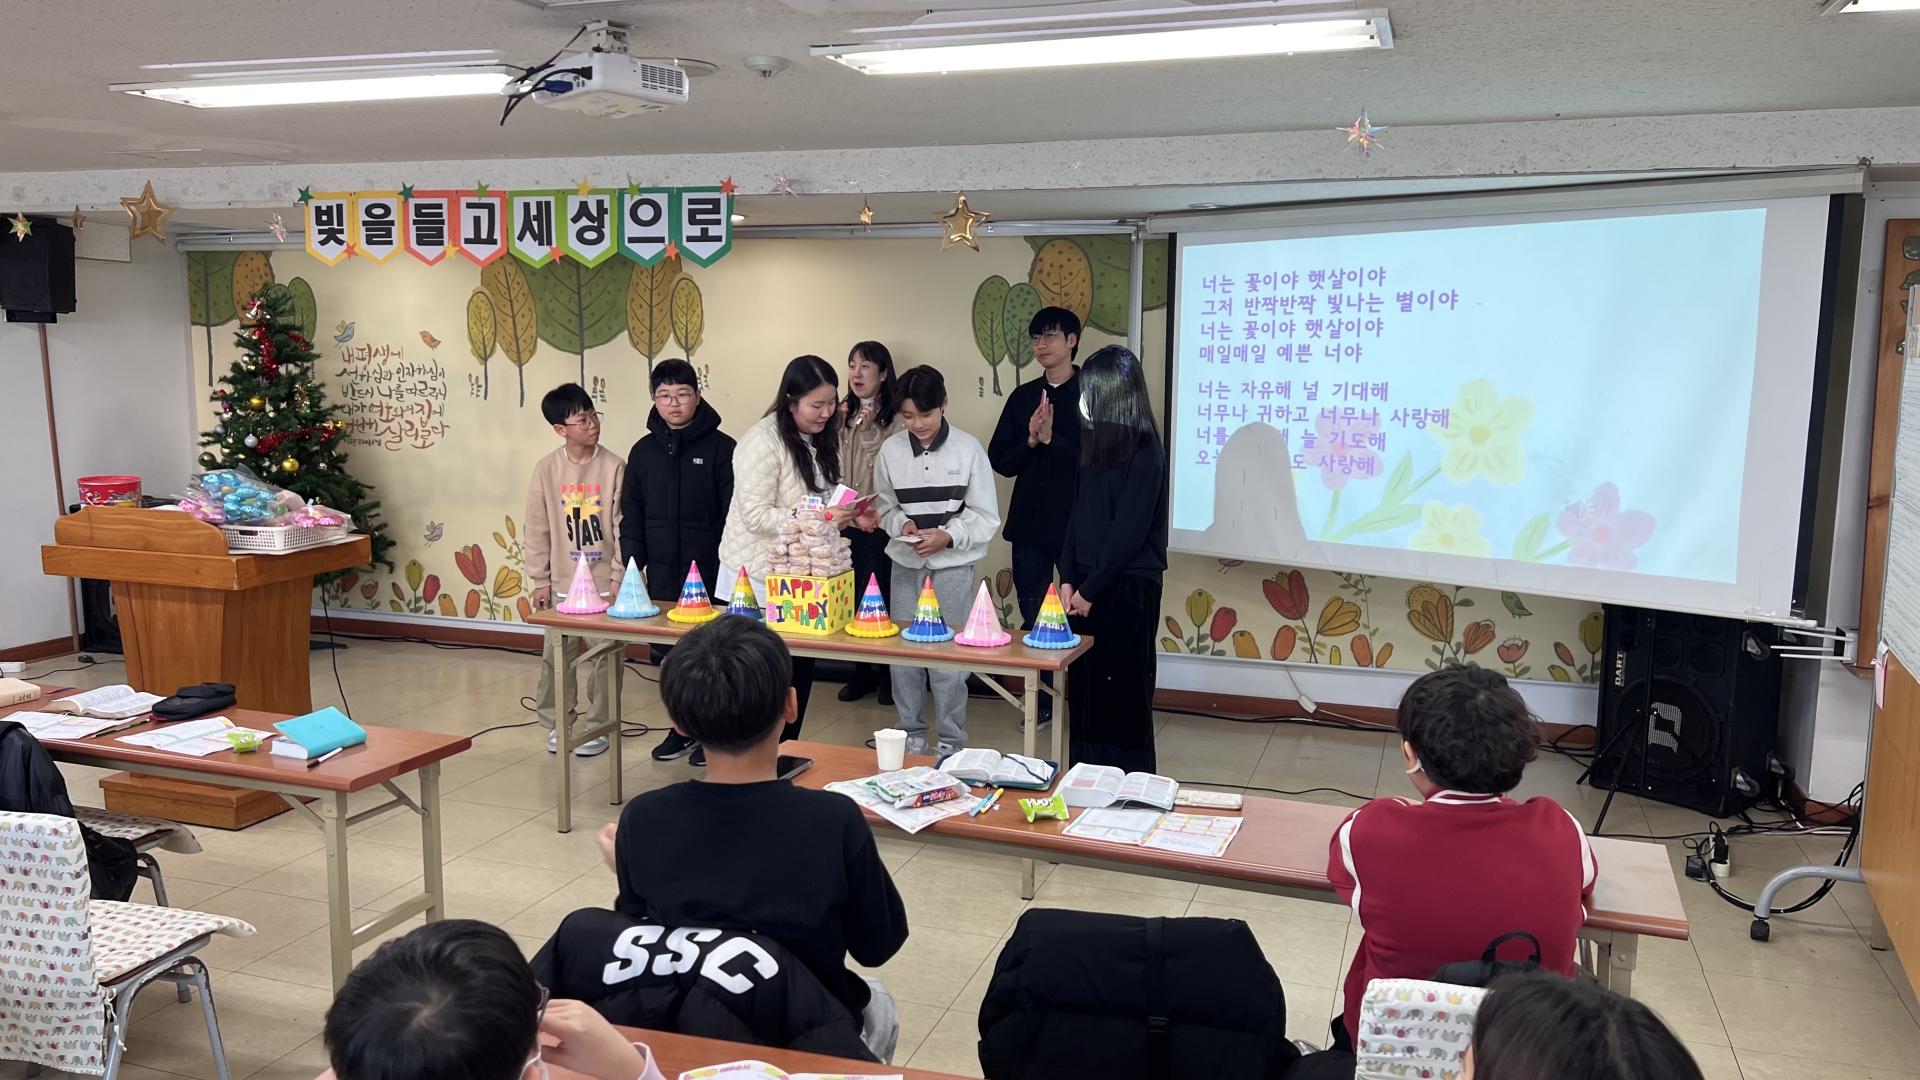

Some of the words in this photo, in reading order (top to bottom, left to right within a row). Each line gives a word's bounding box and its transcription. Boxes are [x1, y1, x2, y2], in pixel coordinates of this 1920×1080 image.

[1202, 274, 1235, 293] 너는
[1245, 271, 1299, 292] 꽃이야
[1308, 266, 1387, 290] 햇살이야
[1201, 298, 1233, 316] 그저
[1244, 295, 1317, 316] 반짝반짝
[1328, 293, 1384, 314] 빛나는
[1396, 289, 1458, 312] 별이야
[1201, 322, 1233, 340] 너는
[1243, 319, 1296, 340] 꽃이야
[1305, 317, 1384, 339] 햇살이야
[1199, 344, 1266, 364] 매일매일
[1277, 344, 1313, 363] 예쁜
[1325, 343, 1363, 363] 너야
[1198, 380, 1231, 399] 너는
[1241, 380, 1291, 400] 자유해
[1303, 381, 1319, 401] 널
[1332, 381, 1389, 402] 기대해
[1197, 404, 1248, 423] 너무나
[1256, 404, 1309, 423] 귀하고
[1320, 406, 1379, 427] 너무나
[1390, 408, 1449, 429] 사랑해
[1301, 430, 1318, 449] 늘
[1329, 431, 1386, 451] 기도해
[1319, 455, 1375, 476] 사랑해
[567, 507, 603, 551] STAR
[768, 577, 823, 600] HAPPY
[1615, 650, 1623, 686] DART
[602, 925, 779, 995] SSC
